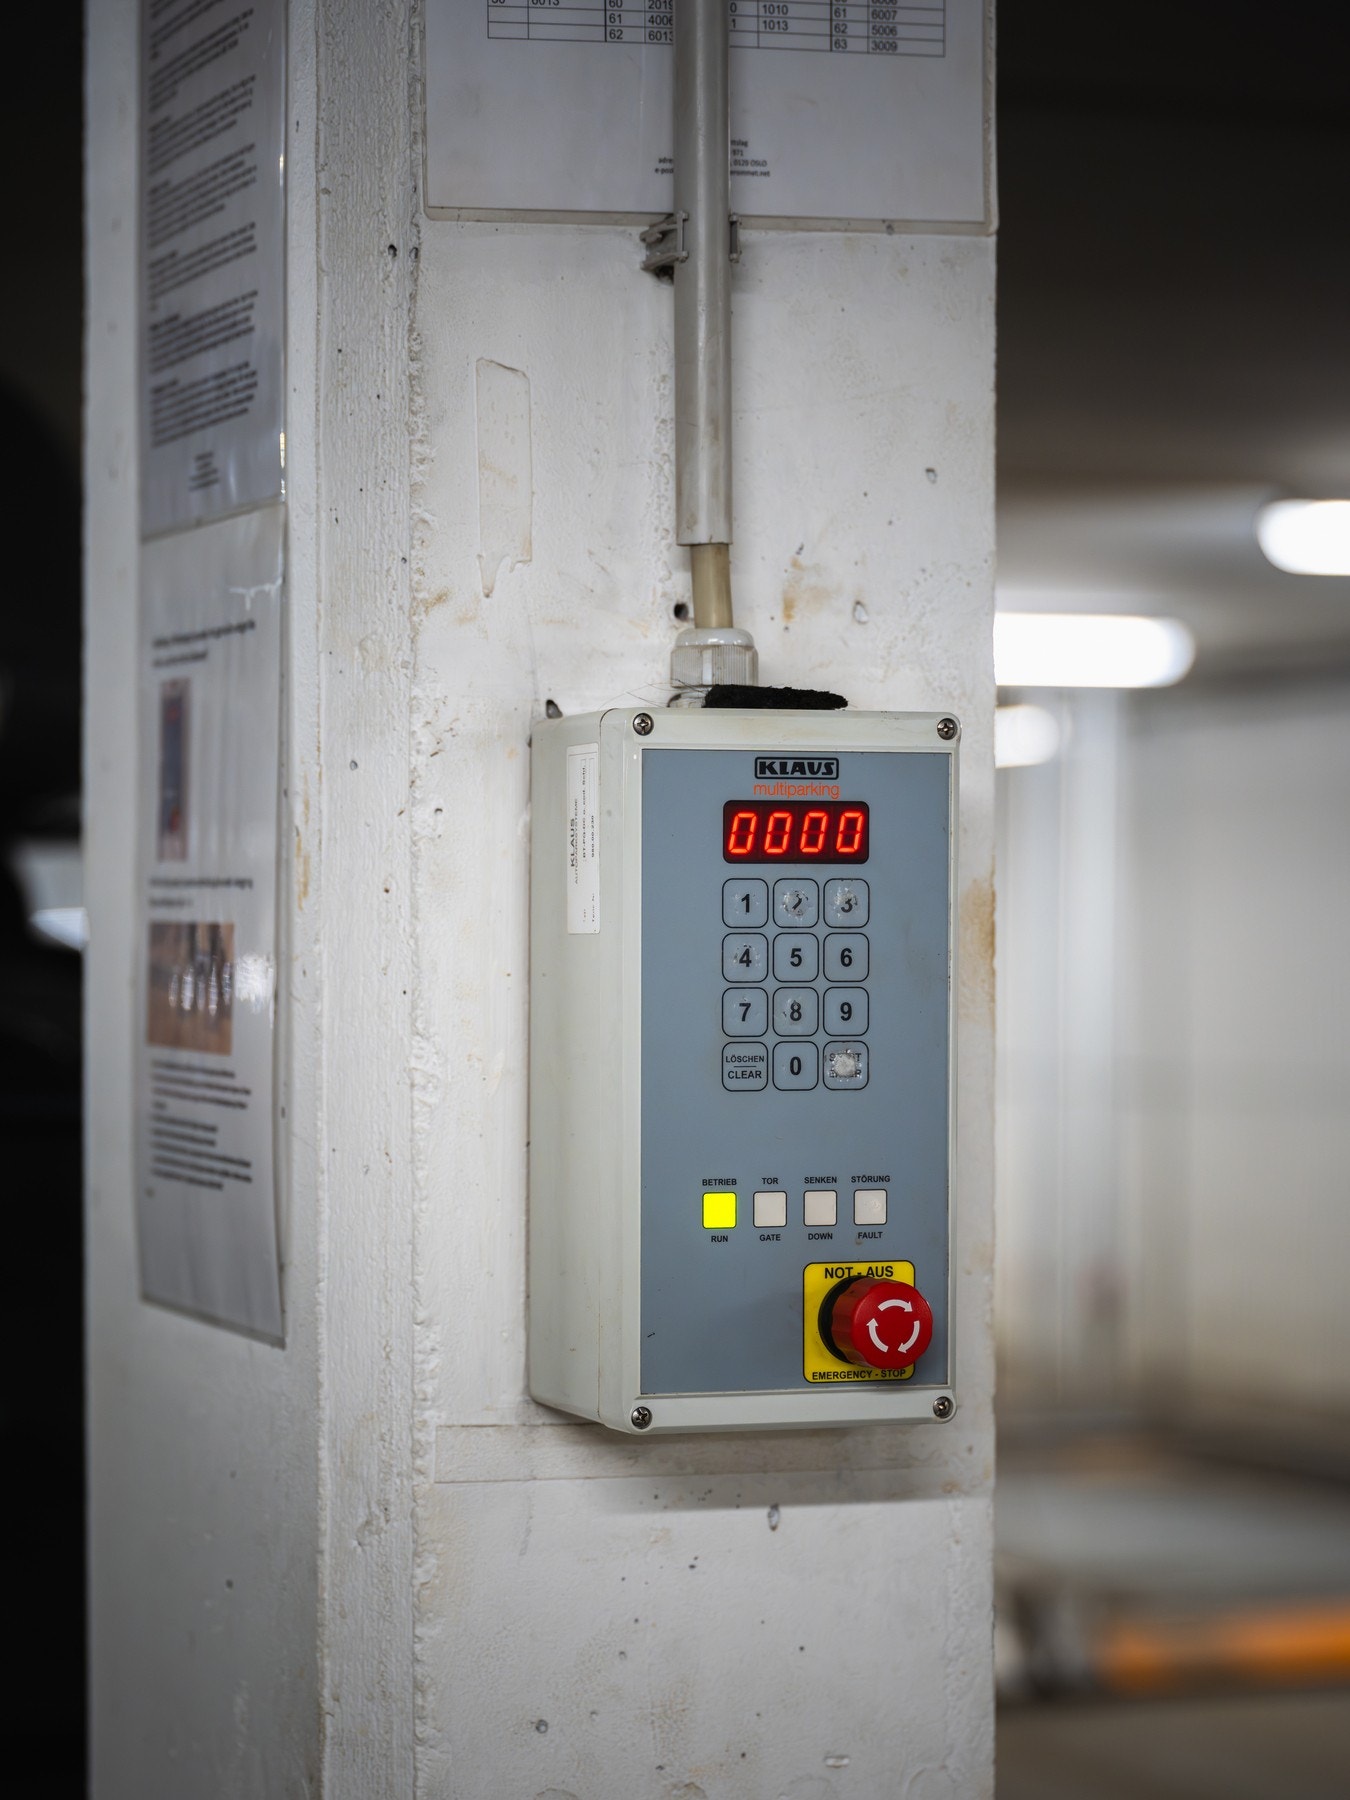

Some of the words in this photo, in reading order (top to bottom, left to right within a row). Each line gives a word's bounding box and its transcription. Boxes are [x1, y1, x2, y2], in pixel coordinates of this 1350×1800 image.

[609, 0, 623, 8] 60
[609, 13, 622, 24] 61
[762, 3, 789, 15] 1010
[834, 8, 847, 18] 61
[871, 9, 898, 21] 6007
[609, 29, 623, 40] 62
[762, 19, 789, 31] 1013
[834, 23, 848, 34] 62
[871, 24, 898, 37] 5006
[834, 39, 848, 50] 63
[871, 40, 898, 52] 3009
[750, 159, 768, 168] OSLO
[759, 761, 835, 776] KLAUS
[753, 781, 840, 800] multiparking
[728, 811, 864, 855] 0000
[741, 893, 750, 913] 1
[840, 895, 853, 913] 3
[739, 948, 752, 967] 4
[790, 948, 803, 967] 5
[840, 948, 853, 967] 6
[739, 1002, 751, 1022] 7
[790, 1001, 802, 1021] 8
[840, 1002, 852, 1021] 9
[725, 1053, 765, 1063] LÖSCHEN
[790, 1056, 802, 1076] 0
[727, 1070, 762, 1080] CLEAR
[702, 1178, 737, 1186] BETRIEB
[762, 1177, 779, 1185] TOR
[804, 1176, 837, 1184] SENKEN
[850, 1174, 891, 1183] STÖRUNG
[711, 1235, 728, 1243] RUN
[759, 1234, 781, 1242] GATE
[808, 1232, 833, 1241] DOWN
[857, 1231, 883, 1240] FAULT
[824, 1266, 853, 1279] NOT
[866, 1265, 894, 1278] AUS
[812, 1369, 873, 1380] EMERGENCY
[881, 1369, 906, 1378] STOP
